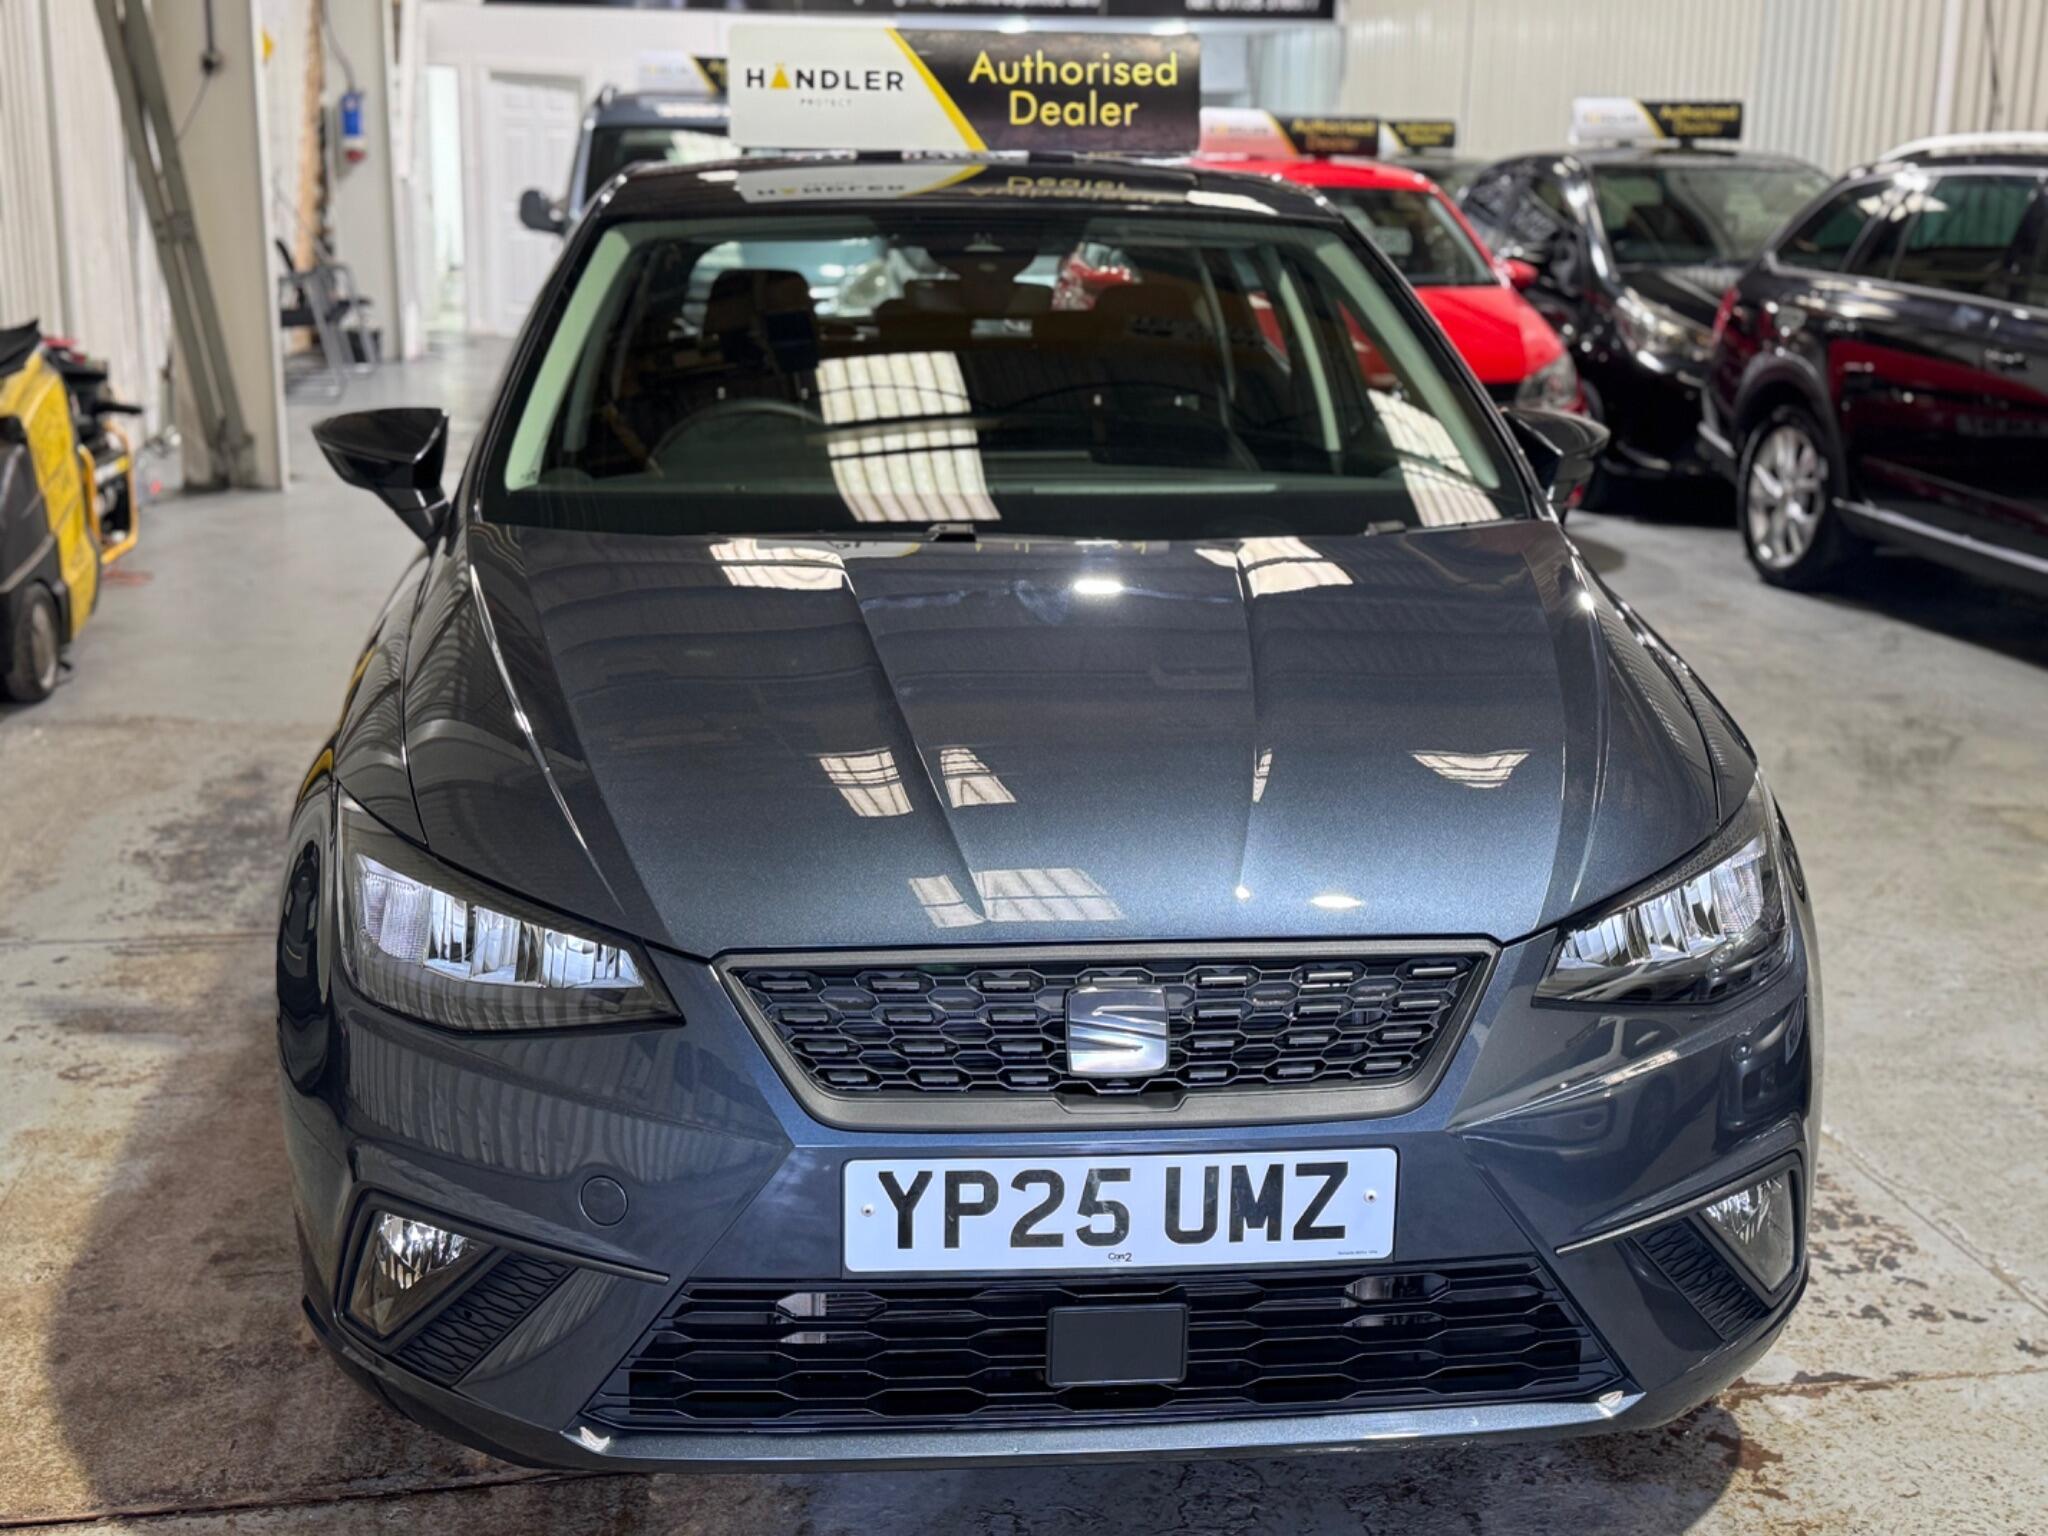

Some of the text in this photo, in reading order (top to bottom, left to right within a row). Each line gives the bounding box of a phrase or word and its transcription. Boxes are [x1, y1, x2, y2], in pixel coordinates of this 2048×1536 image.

[968, 48, 1179, 87] Authorised
[1009, 89, 1140, 127] Dealer
[878, 1161, 1349, 1249] YP25 UMZ
